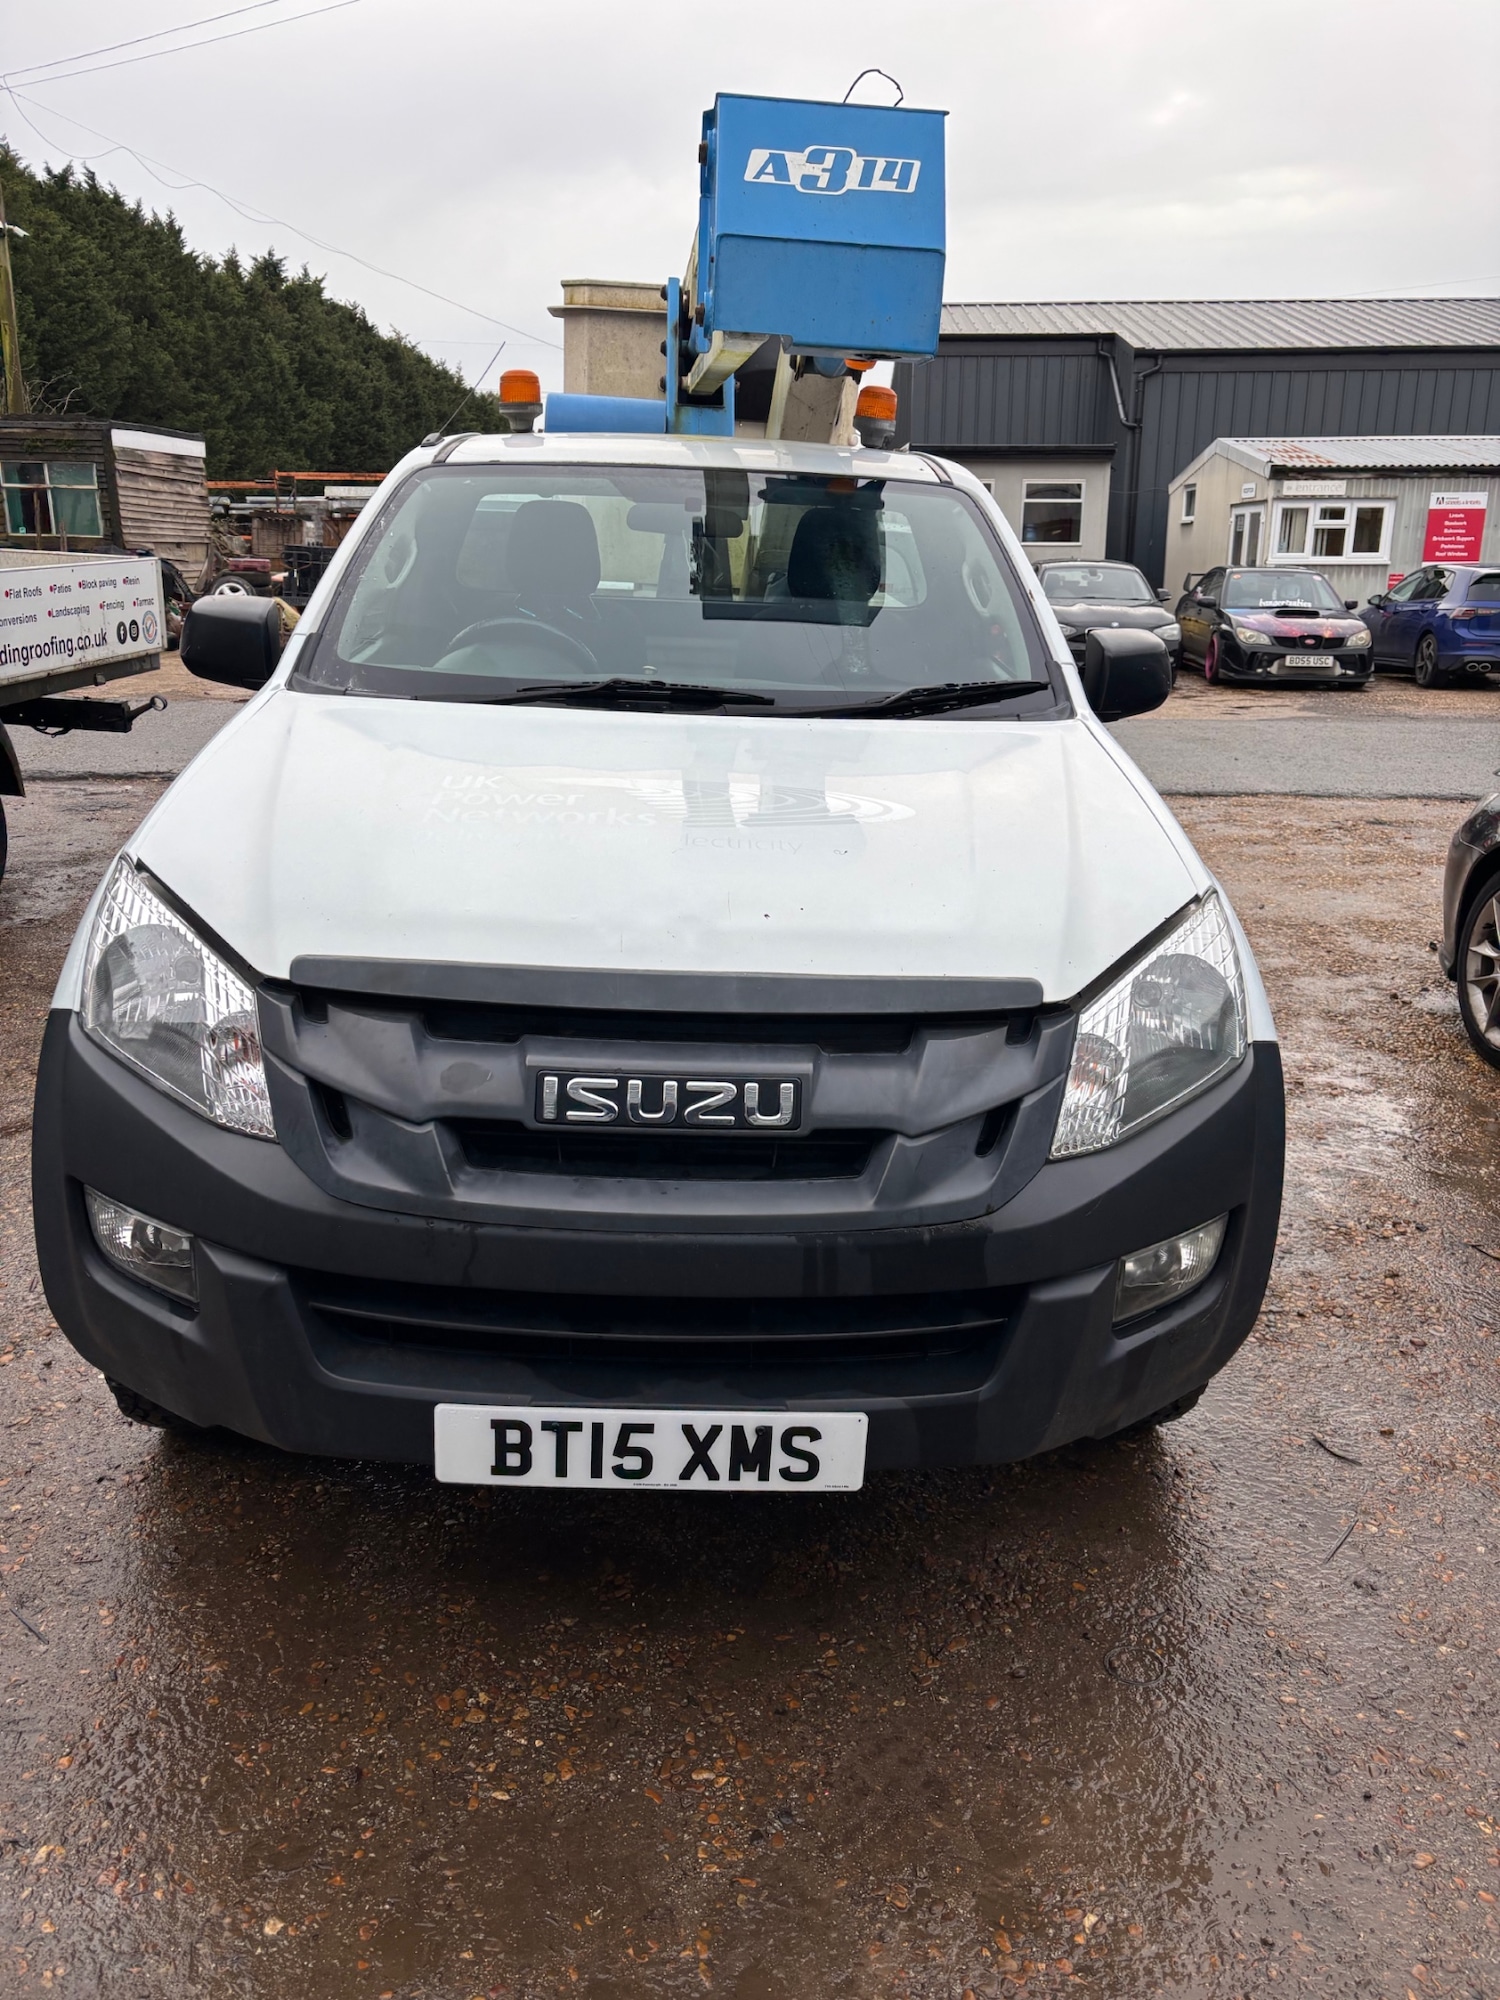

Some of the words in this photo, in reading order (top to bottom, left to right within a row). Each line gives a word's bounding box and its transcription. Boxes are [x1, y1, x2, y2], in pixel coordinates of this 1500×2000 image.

[1295, 482, 1343, 493] entrance
[81, 579, 98, 590] Block
[98, 577, 117, 589] paving
[125, 576, 140, 586] Resin
[9, 588, 22, 600] Flat
[23, 586, 43, 598] Roofs
[53, 583, 72, 594] Patios
[102, 599, 125, 611] Fencing
[136, 597, 155, 607] Tarmac
[52, 604, 90, 618] Landscaping
[1312, 656, 1331, 665] USC
[439, 774, 508, 790] UK
[431, 789, 585, 807] Power
[421, 807, 658, 827] Networks
[542, 1075, 795, 1127] ISUZU
[490, 1418, 656, 1479] BT15
[678, 1423, 823, 1483] XMS
